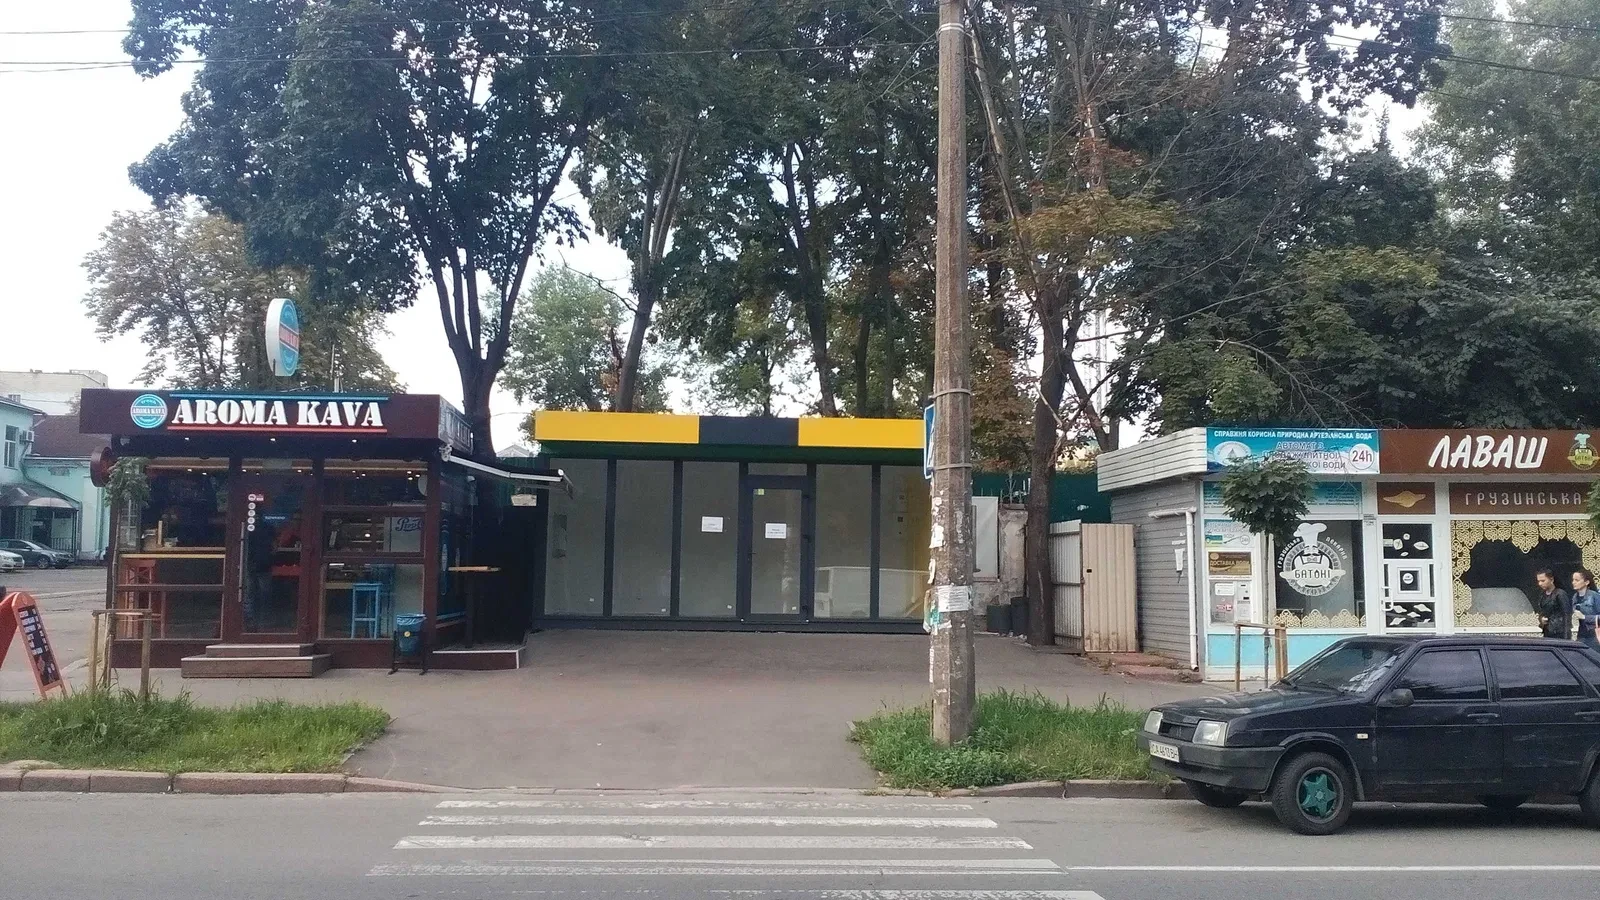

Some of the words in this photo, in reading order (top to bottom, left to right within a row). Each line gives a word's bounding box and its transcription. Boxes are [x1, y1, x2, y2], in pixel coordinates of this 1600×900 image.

[172, 399, 288, 425] AROMA
[297, 400, 383, 427] KAVA
[1214, 430, 1247, 438] СПРАВЖНЯ
[1277, 431, 1309, 439] ПРИРОДНА
[1355, 432, 1372, 440] ВОДА
[1276, 441, 1316, 450] АВТОМАТ
[1428, 434, 1548, 468] ЛАВАШ
[1352, 450, 1372, 462] 24h
[1323, 461, 1346, 469] ВОДИ
[1465, 492, 1582, 506] ГРУЗИНСЬКА
[1294, 569, 1331, 579] БАТОНІ
